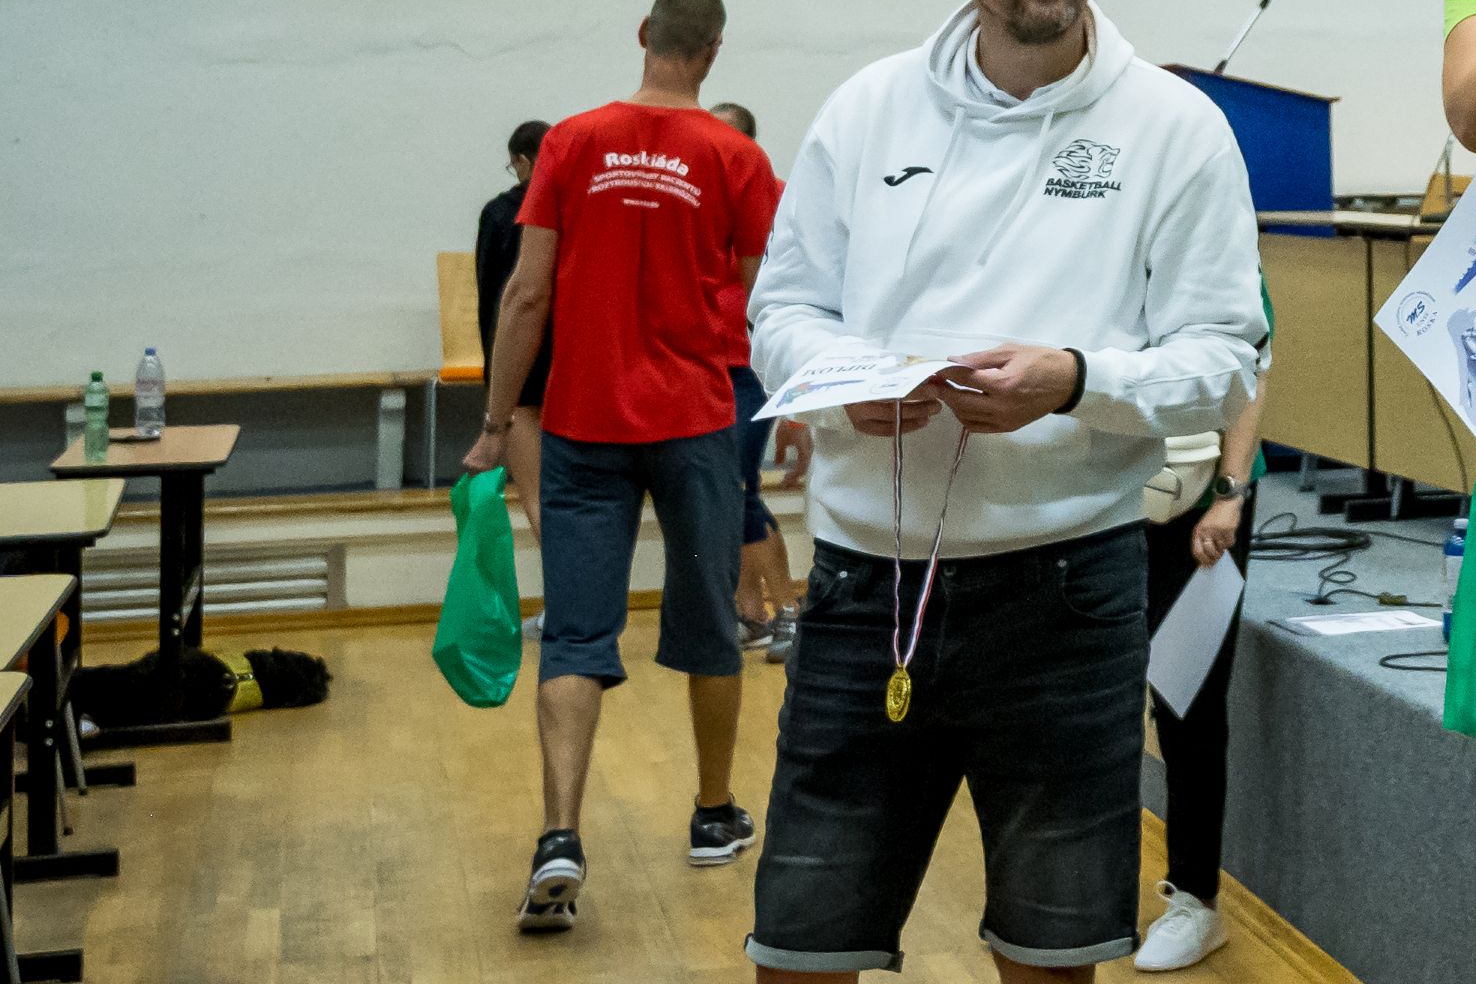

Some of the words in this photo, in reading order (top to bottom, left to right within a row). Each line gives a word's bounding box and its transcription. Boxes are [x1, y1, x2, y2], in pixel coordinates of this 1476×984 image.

[605, 150, 689, 176] Roskiáda
[1046, 178, 1121, 191] BASKETBALL
[1044, 187, 1107, 199] NYMBURK
